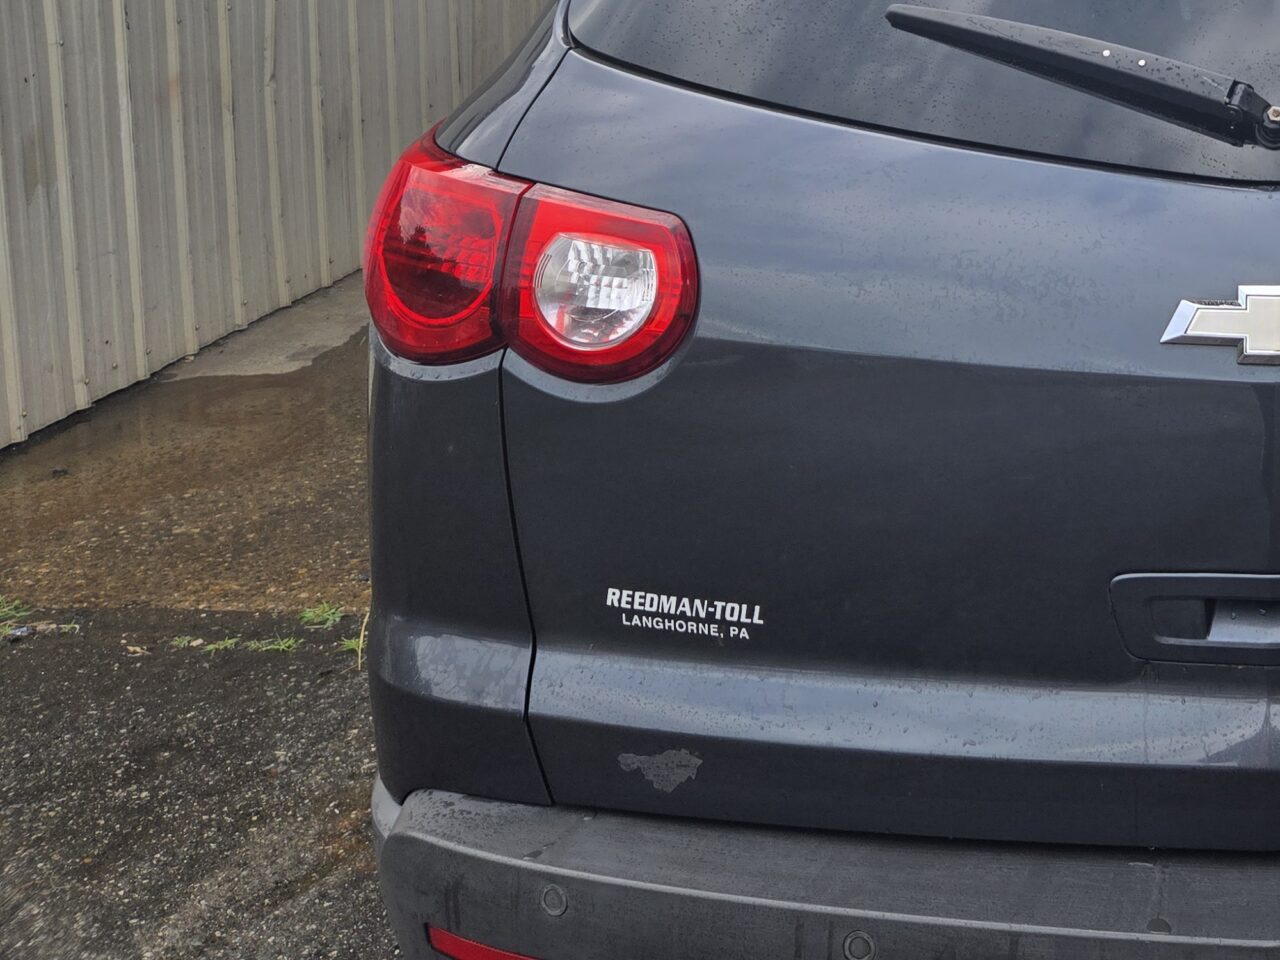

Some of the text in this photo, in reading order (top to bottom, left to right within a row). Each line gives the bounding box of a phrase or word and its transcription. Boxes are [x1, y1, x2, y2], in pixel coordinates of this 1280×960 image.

[606, 587, 764, 625] REEDMAN-TOLL
[621, 612, 750, 640] LANGHORNE, PA
